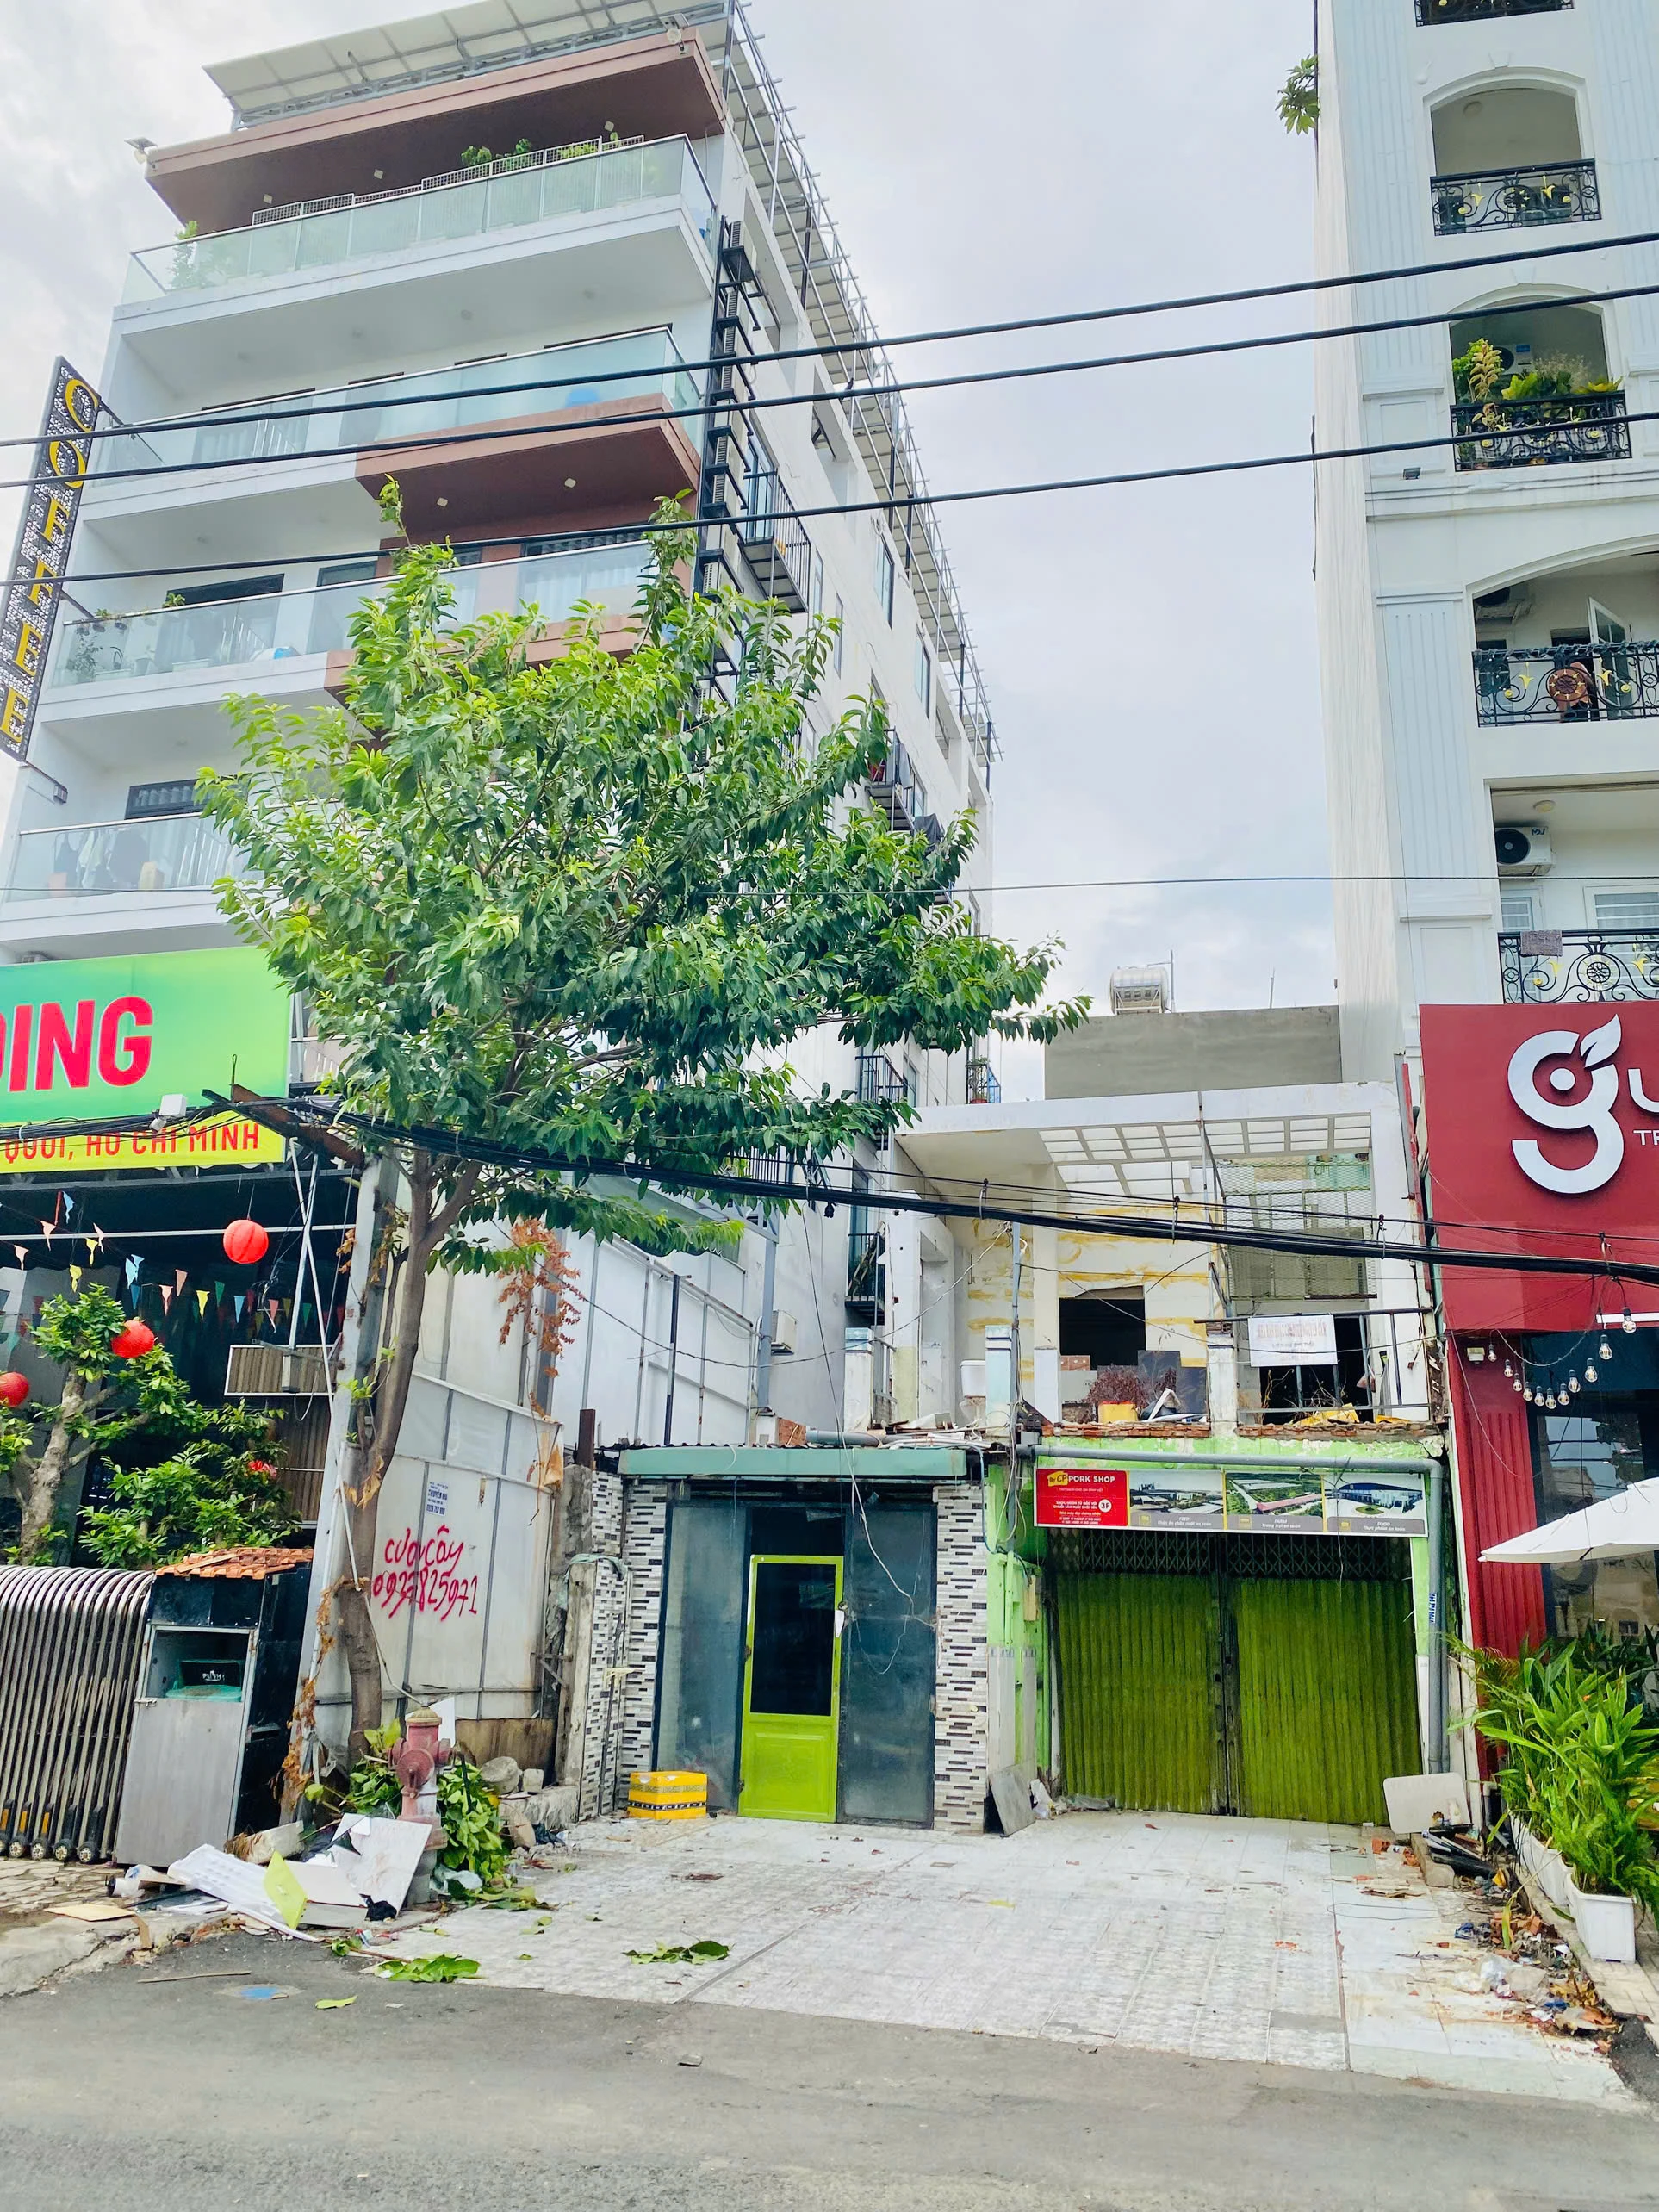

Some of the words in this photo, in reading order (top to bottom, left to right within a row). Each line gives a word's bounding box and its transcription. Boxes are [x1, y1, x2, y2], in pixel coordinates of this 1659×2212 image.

[0, 377, 100, 744] COFFEE
[0, 996, 154, 1092] ING
[189, 1122, 260, 1153] MINH
